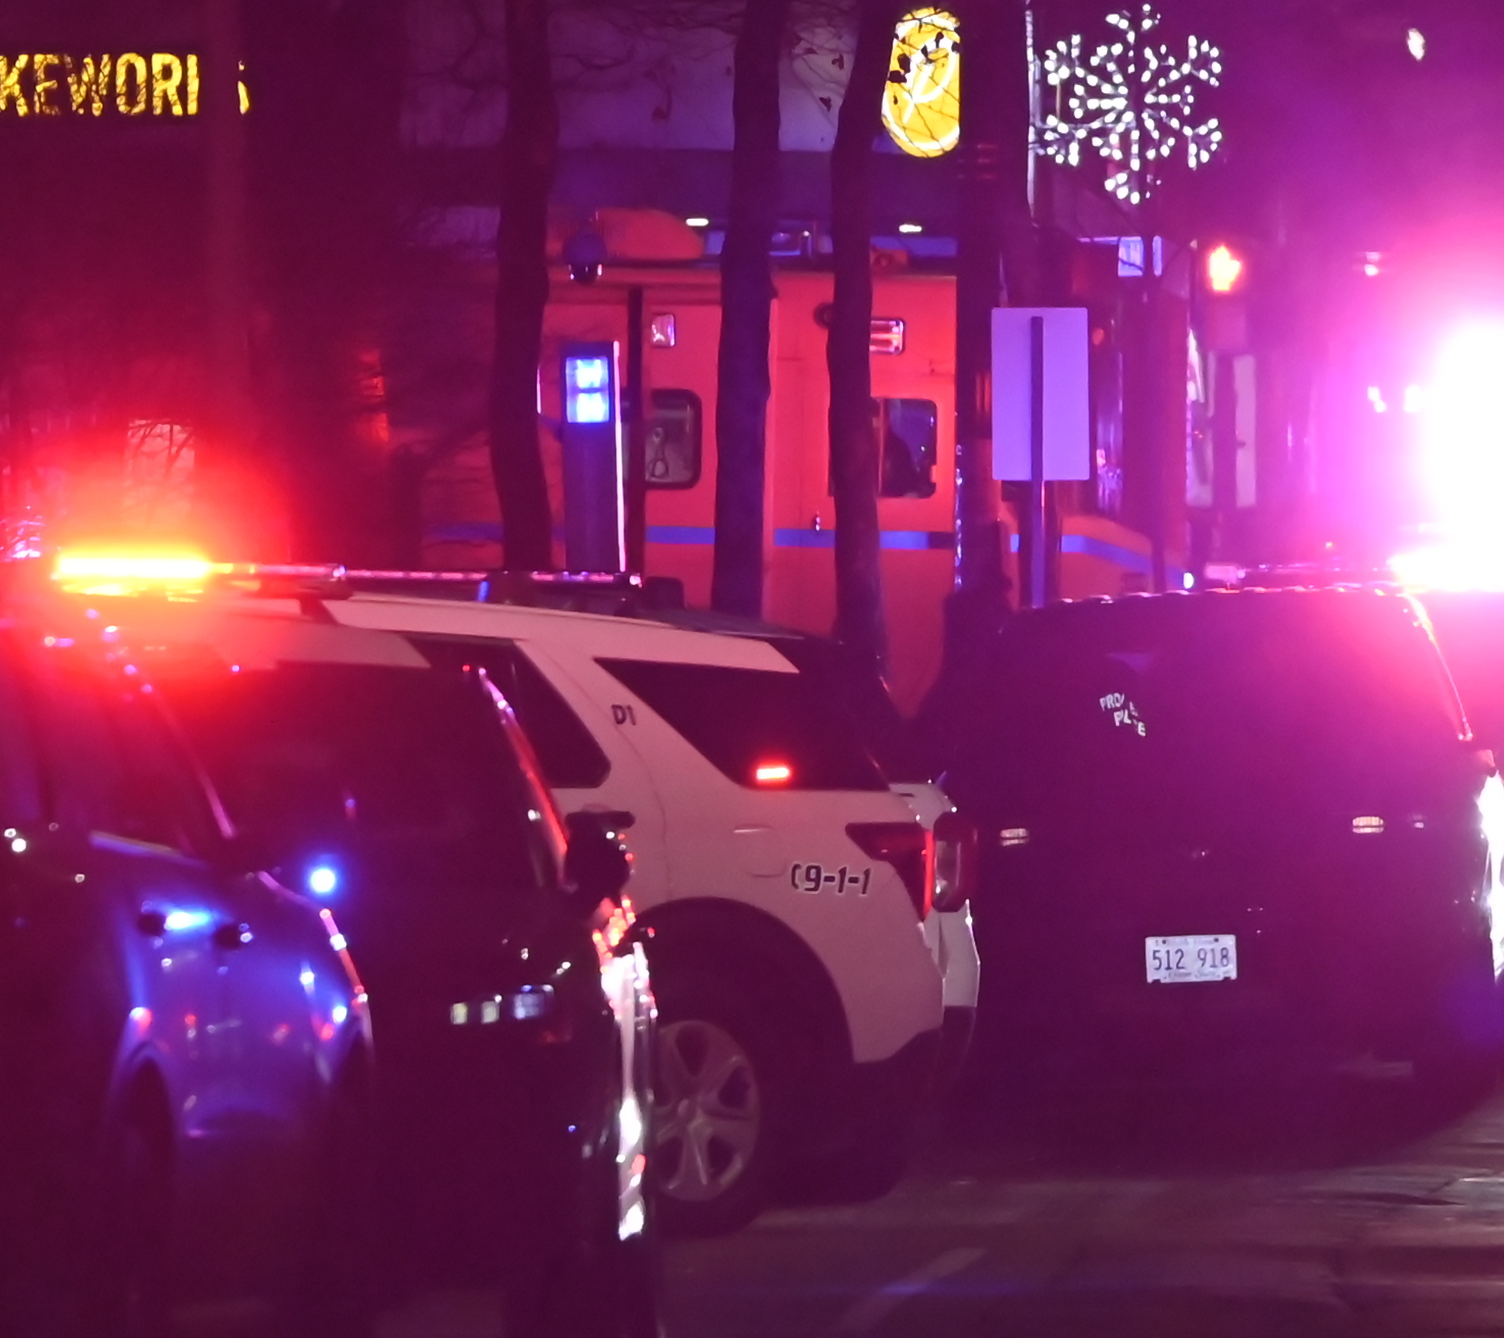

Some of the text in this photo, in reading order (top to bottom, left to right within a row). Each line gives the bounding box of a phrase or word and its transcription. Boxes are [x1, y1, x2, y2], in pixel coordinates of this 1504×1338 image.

[804, 864, 871, 896] 9-1-1
[1152, 947, 1229, 971] 512 918
